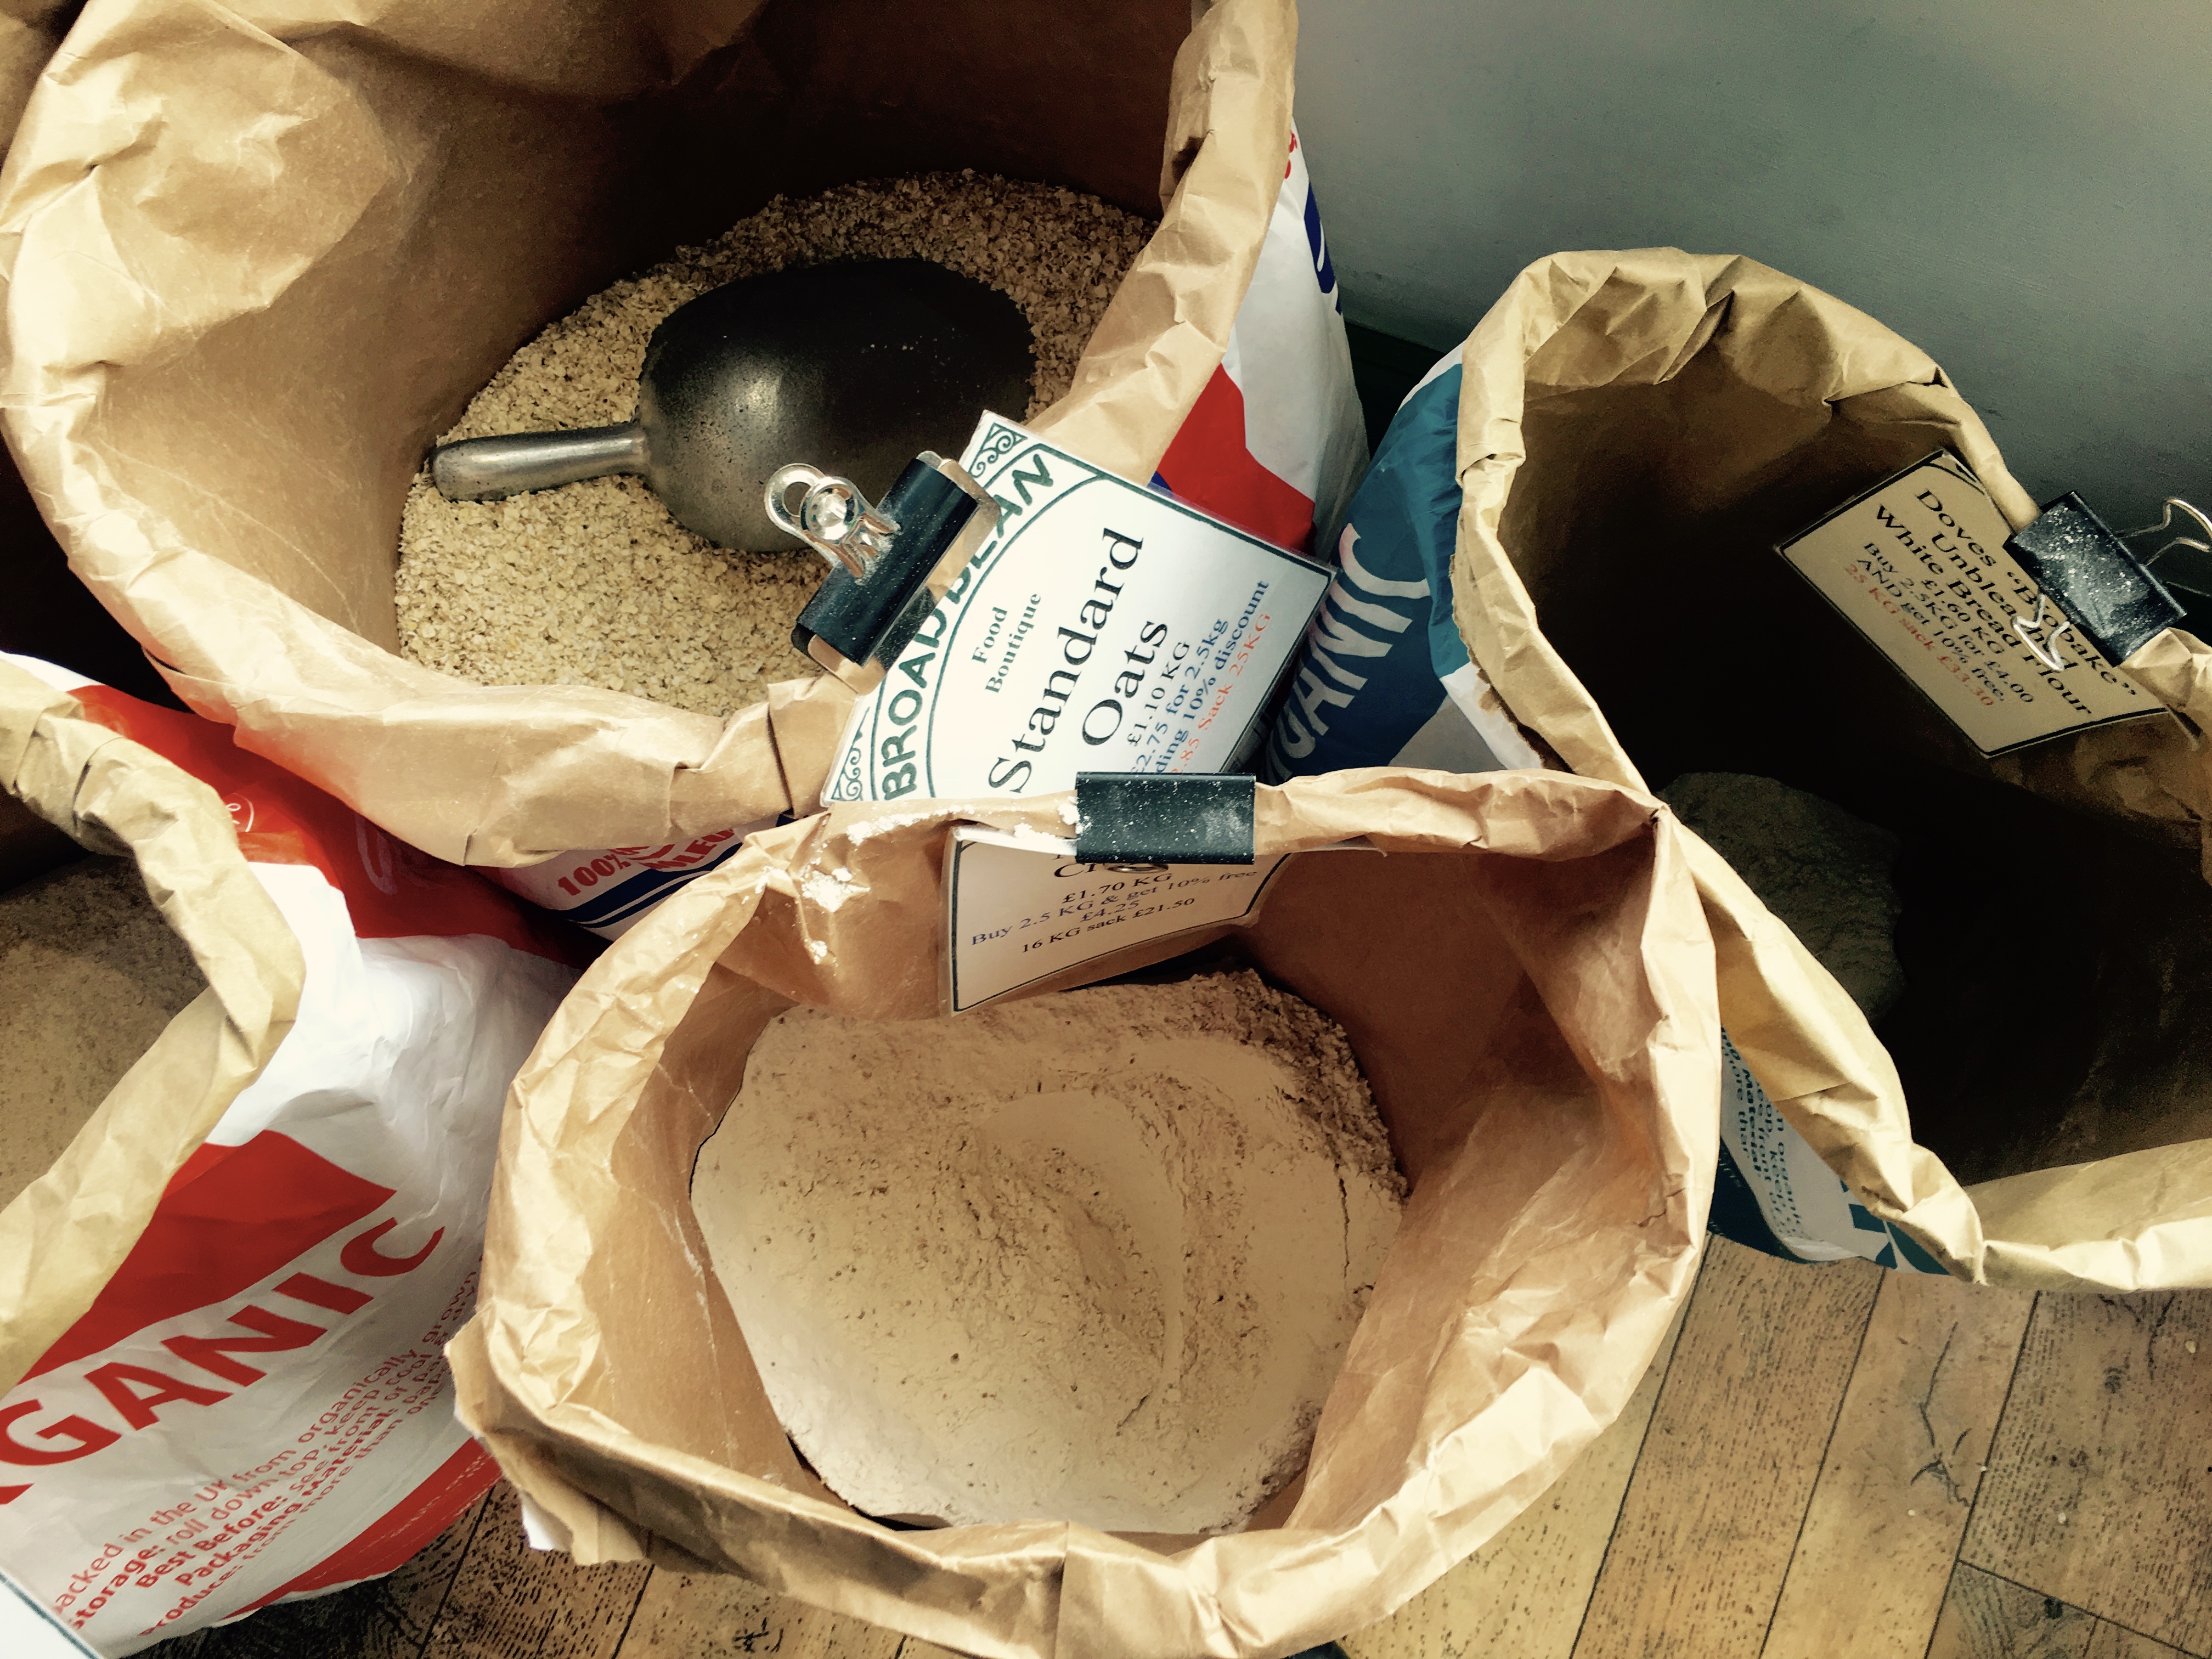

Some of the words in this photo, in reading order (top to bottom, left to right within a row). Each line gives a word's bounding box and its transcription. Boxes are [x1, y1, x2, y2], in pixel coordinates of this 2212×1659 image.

[1876, 504, 1945, 577] White
[1947, 579, 2022, 650] Bread
[1915, 490, 1997, 568] Doves
[972, 606, 1008, 666] Food
[985, 593, 1042, 694] Boutique
[1843, 563, 1867, 585] 25
[1868, 585, 1899, 615] KG
[1857, 559, 1903, 600] AND
[1901, 602, 1931, 628] get
[1933, 629, 1968, 664] 10%
[1864, 542, 1899, 575] Buy
[1901, 578, 1957, 632] 2.5KG
[1957, 632, 1985, 659] for
[1984, 659, 2034, 705] £4.00
[1920, 579, 1972, 623] £1.60
[1971, 626, 2006, 656] KG
[988, 528, 1145, 794] Standard
[1082, 621, 1167, 746] Oats
[1127, 687, 1165, 747] £1.10
[1161, 641, 1189, 682] KG
[1166, 684, 1189, 716] for
[1184, 618, 1229, 680] 2.5kg
[1183, 677, 1216, 720] 10%
[1215, 580, 1269, 670] discount
[1198, 683, 1234, 731] Sack
[1229, 614, 1271, 677] 25KG
[1266, 522, 1431, 781] GANIC
[557, 854, 631, 896] 100%
[971, 926, 1013, 946] Buy
[1020, 911, 1051, 928] 2.5
[1058, 900, 1095, 917] KG
[1101, 895, 1121, 906] &
[1127, 887, 1158, 902] get
[1166, 876, 1211, 890] 10%
[1217, 870, 1259, 881] free
[1022, 939, 1043, 953] 16
[1048, 927, 1081, 943] KG
[1087, 916, 1127, 932] sack
[1133, 898, 1196, 918] £21.50
[1063, 882, 1126, 904] £1.70
[1133, 874, 1173, 888] KG
[1079, 900, 1140, 923] £4.25
[0, 1216, 445, 1506] GANIC
[54, 1543, 125, 1614] acked
[119, 1527, 153, 1544] in
[149, 1502, 198, 1526] the
[194, 1479, 227, 1502] UK
[232, 1449, 297, 1482] from
[297, 1349, 417, 1443] organically
[421, 1271, 477, 1343] grown
[134, 1550, 197, 1588] Best
[193, 1495, 289, 1551] Before:
[289, 1458, 329, 1493] see
[329, 1406, 381, 1454] front
[385, 1386, 408, 1401] of
[166, 1518, 209, 1545] roll
[210, 1479, 279, 1521] down
[324, 1390, 380, 1436] keep
[386, 1353, 432, 1386] cool
[174, 1502, 303, 1587] Packaging
[303, 1407, 398, 1498] Material:
[242, 1518, 297, 1561] from
[302, 1464, 353, 1513] more
[353, 1419, 403, 1462] than
